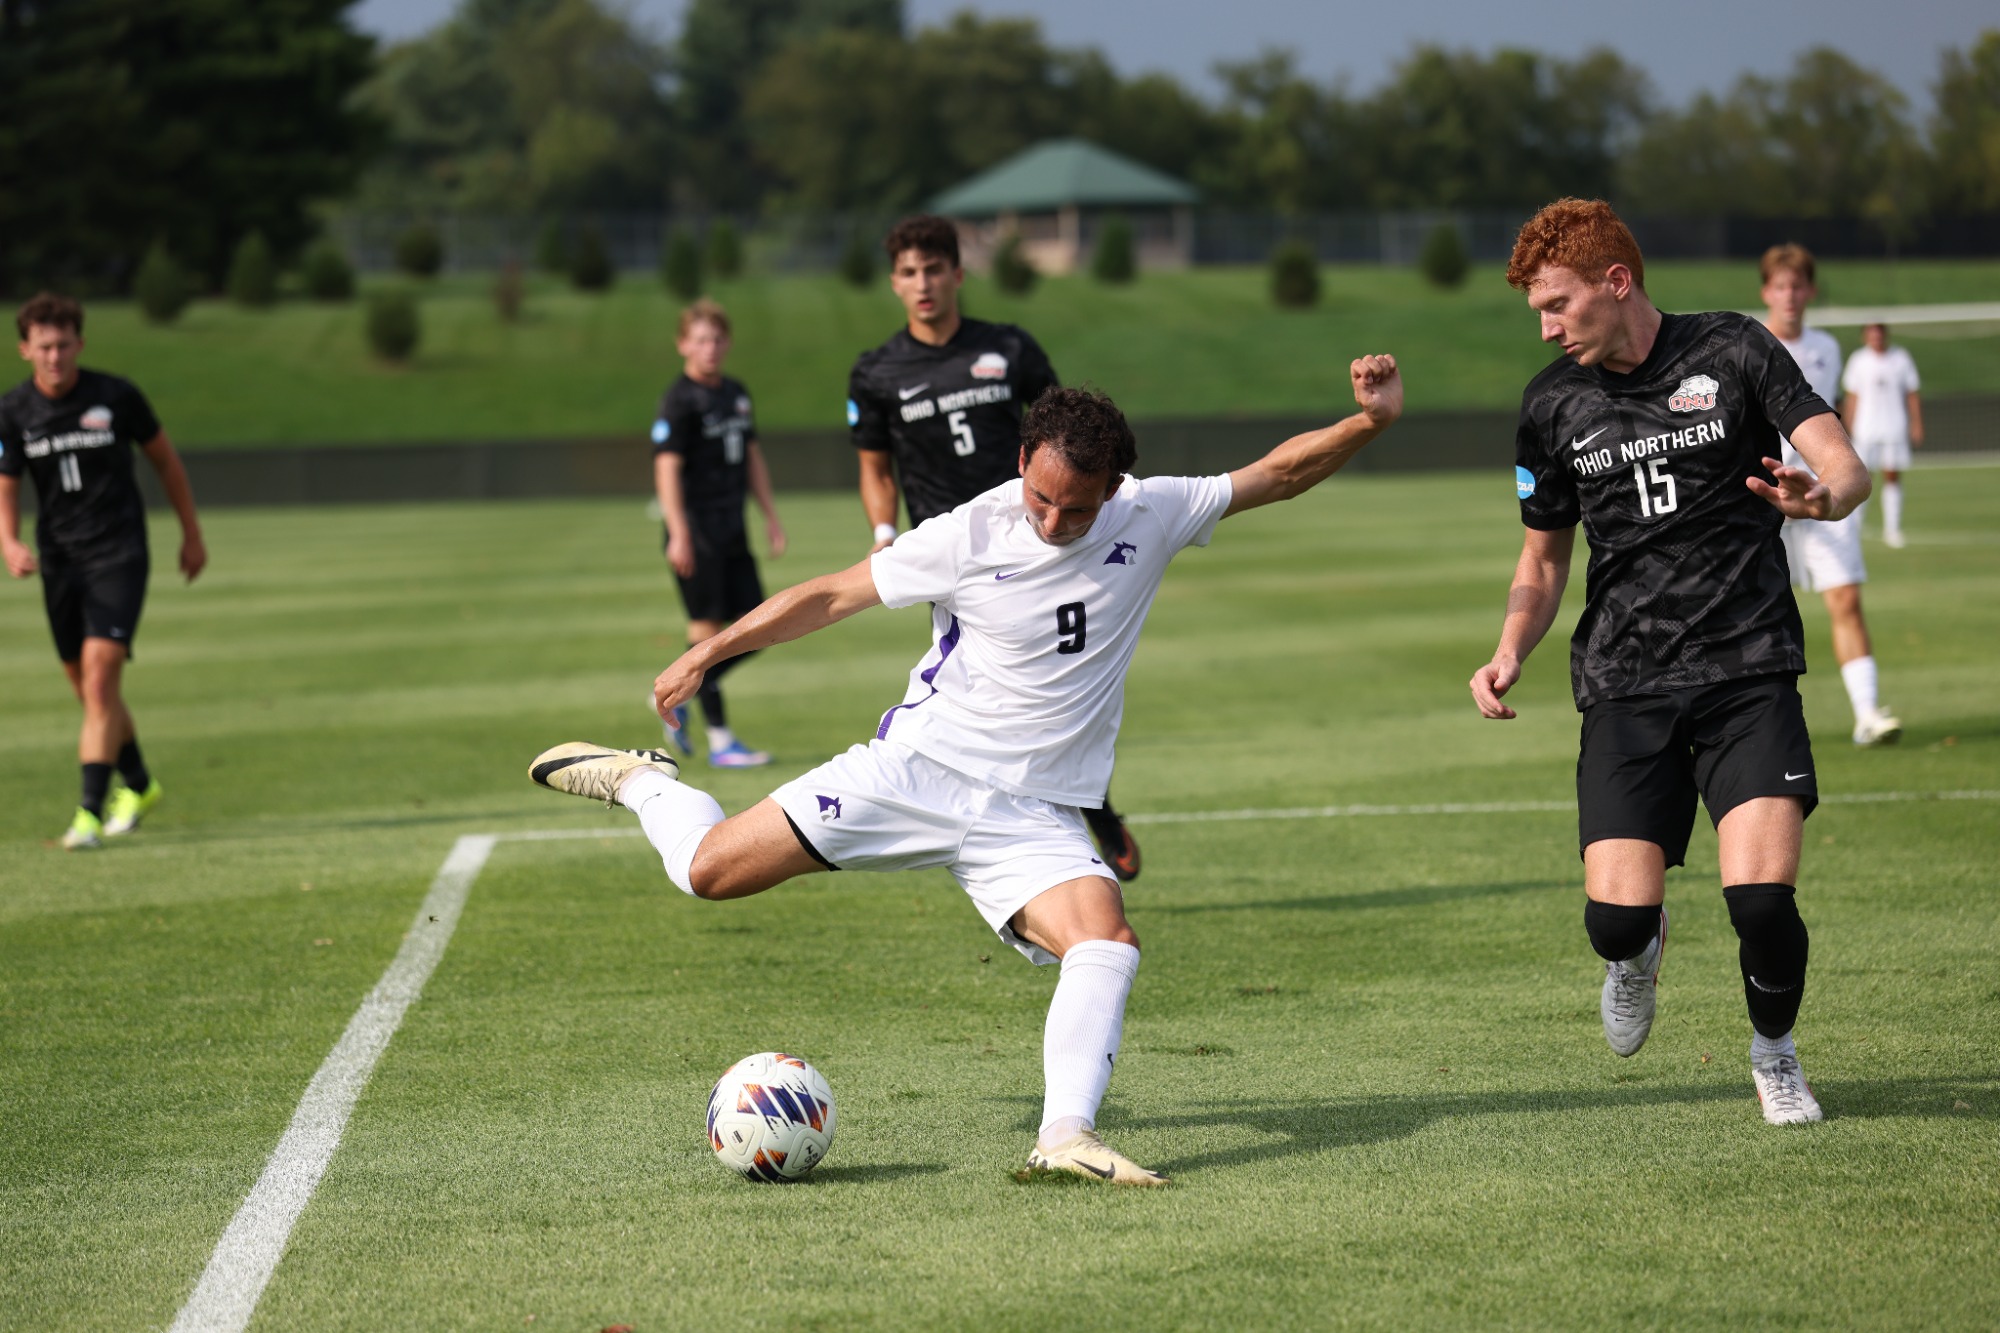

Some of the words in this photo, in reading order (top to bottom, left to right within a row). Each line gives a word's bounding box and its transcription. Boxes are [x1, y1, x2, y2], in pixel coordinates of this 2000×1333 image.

[1669, 393, 1715, 411] ONU
[948, 411, 975, 456] 5
[1573, 448, 1613, 476] OHIO
[1620, 419, 1725, 463] NORTHERN
[59, 452, 82, 492] 11
[1633, 457, 1677, 517] 15
[1056, 601, 1087, 655] 9
